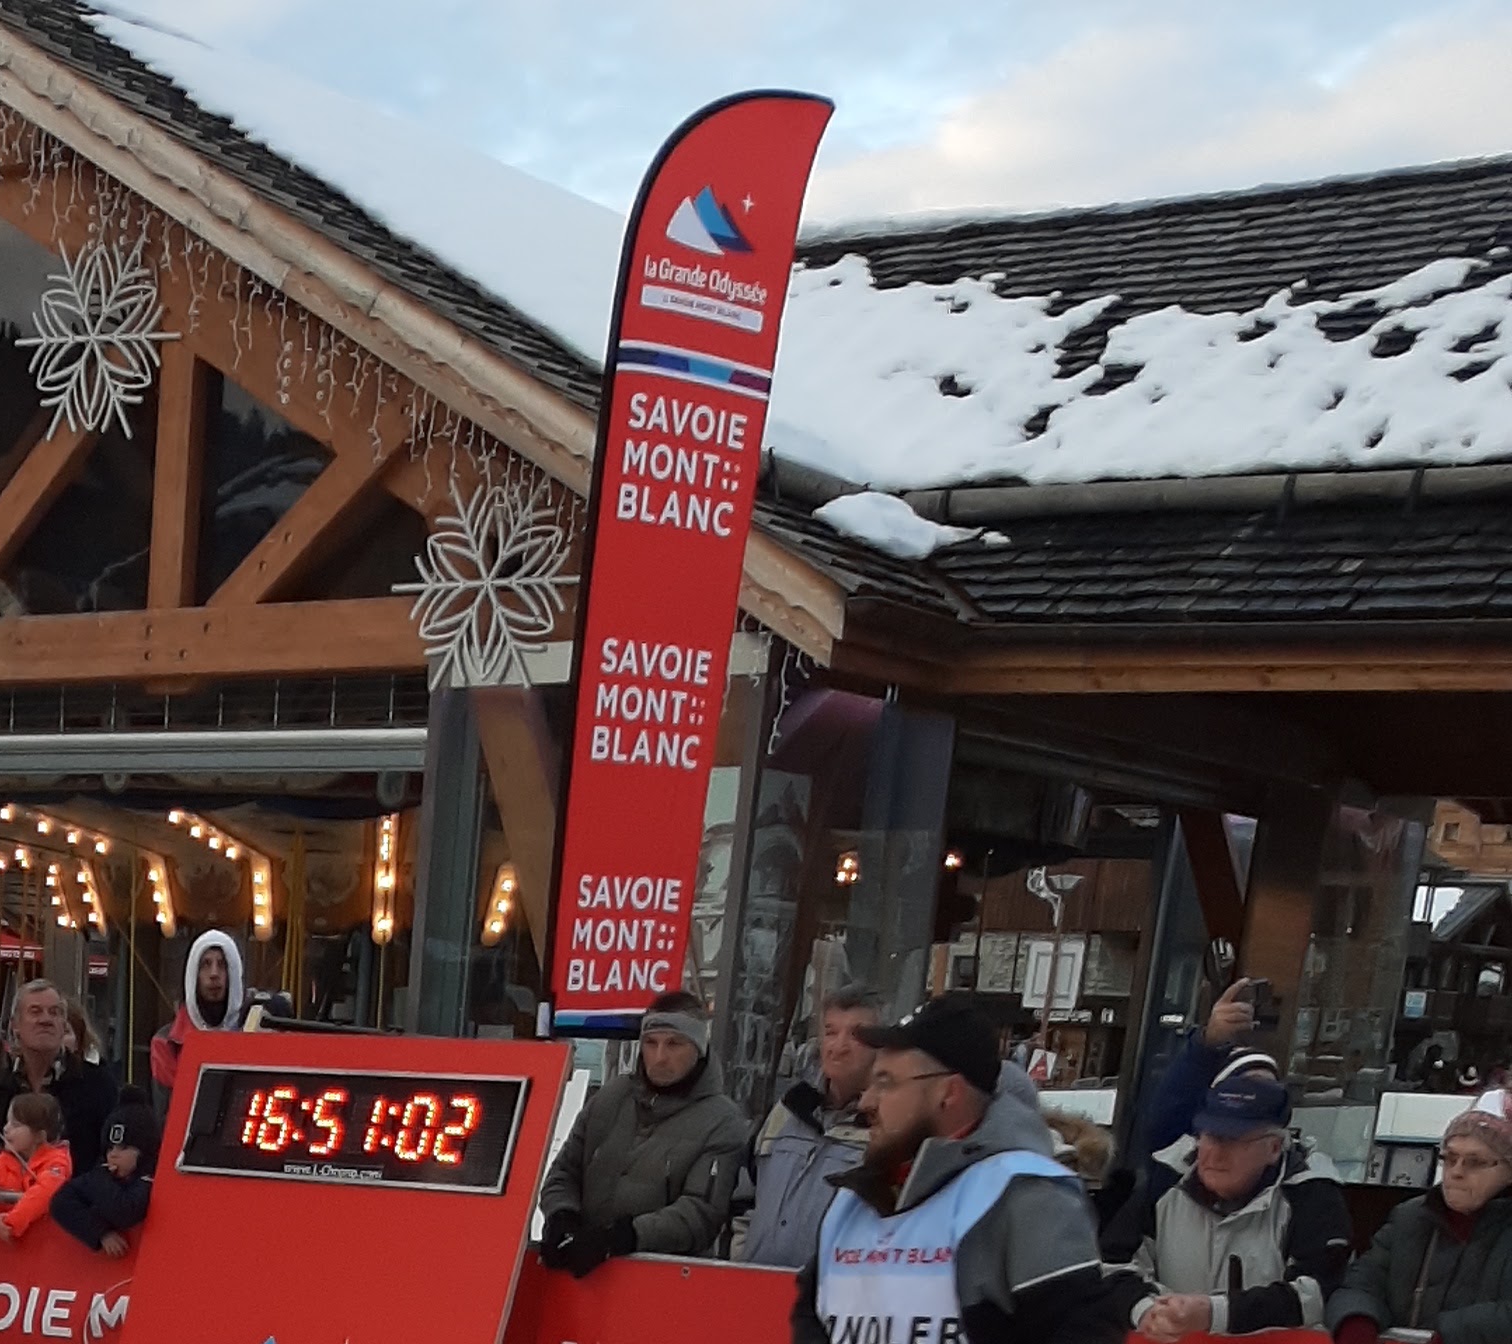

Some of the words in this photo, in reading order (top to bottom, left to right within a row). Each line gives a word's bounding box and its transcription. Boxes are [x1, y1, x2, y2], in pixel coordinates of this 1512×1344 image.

[659, 257, 707, 288] Grande
[628, 392, 748, 450] SAVOIE
[622, 438, 721, 489] MONT
[617, 482, 735, 538] BLANC
[600, 638, 713, 685] SAVOIE
[594, 683, 687, 725] MONT
[590, 725, 700, 770] BLANC
[577, 875, 683, 913] SAVOIE
[572, 918, 656, 952] MONT
[567, 959, 671, 993] BLANC
